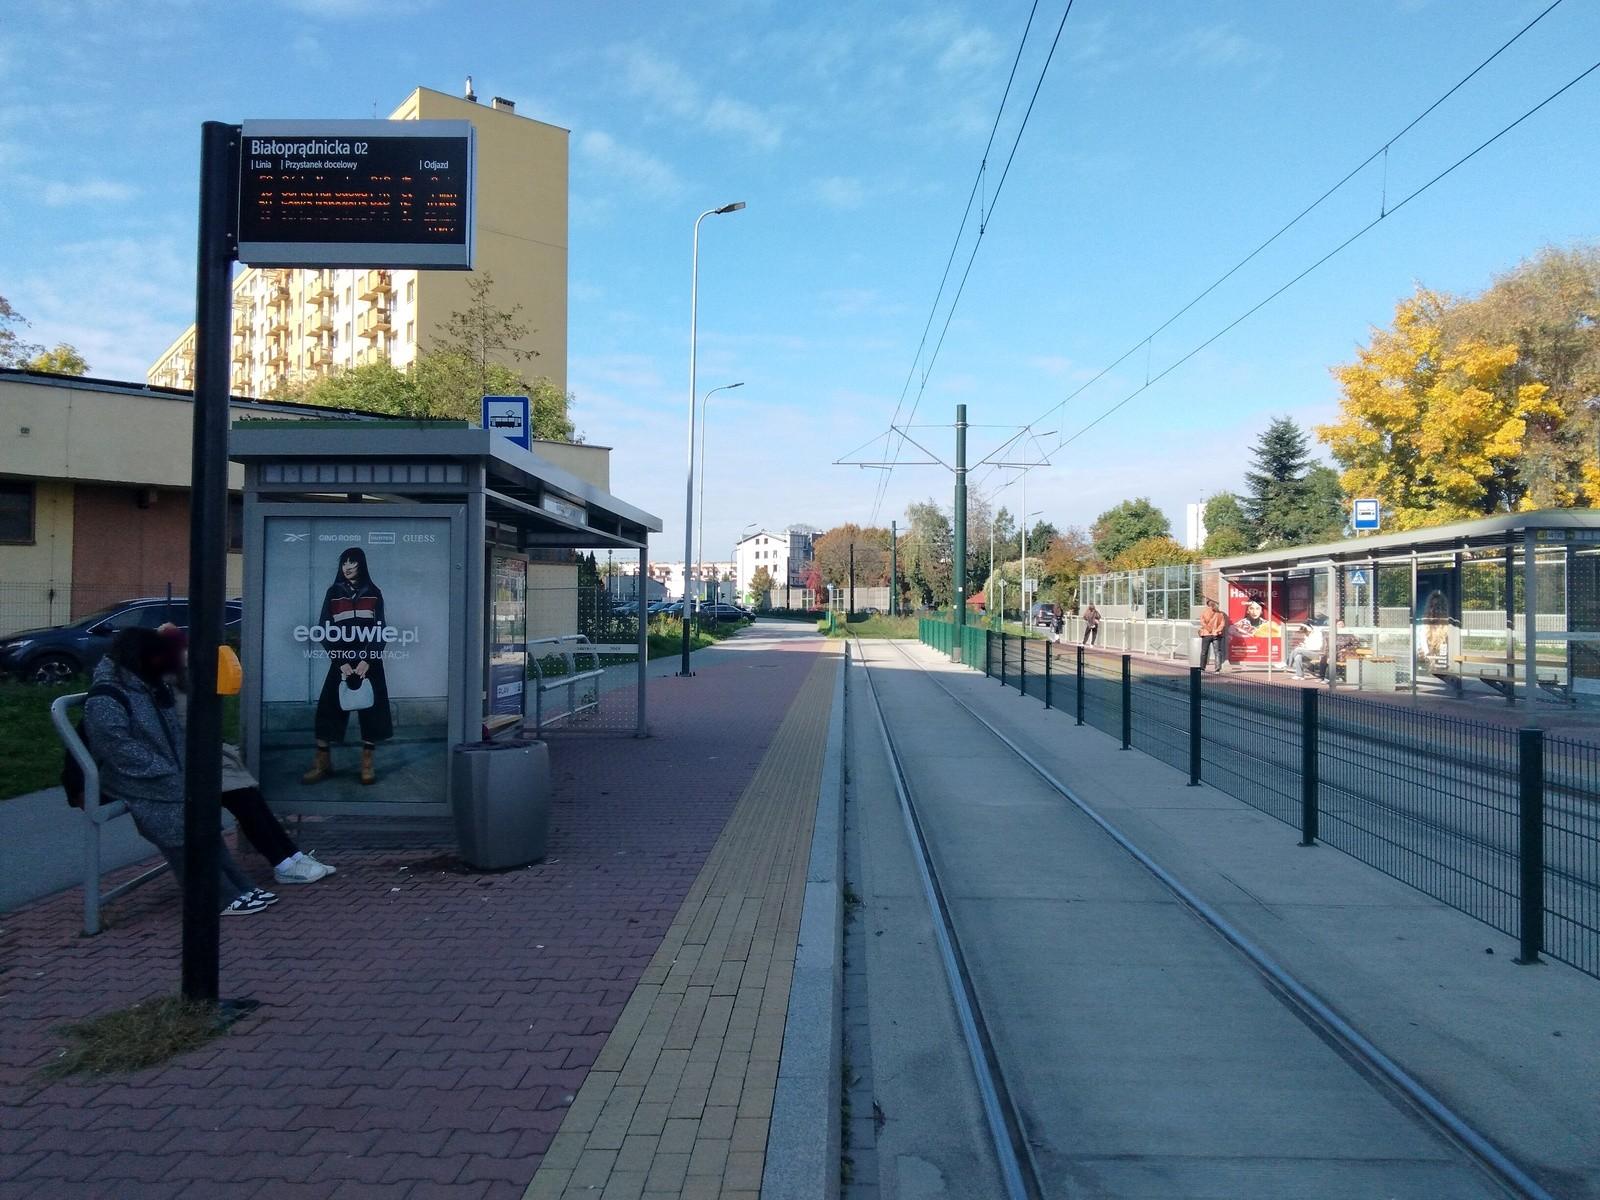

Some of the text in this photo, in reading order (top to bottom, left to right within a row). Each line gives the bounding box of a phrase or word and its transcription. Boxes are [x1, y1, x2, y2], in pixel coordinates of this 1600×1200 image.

[251, 139, 368, 158] Białoprądnicka 02
[255, 160, 272, 169] Linia
[285, 160, 357, 171] Przystanek docelowy
[424, 160, 449, 171] Odjazd
[402, 534, 435, 542] GUESS
[1230, 588, 1279, 597] HalfPrie
[293, 620, 419, 646] eobuwie.pl
[303, 650, 410, 659] WSZYSTKO O BUTACH
